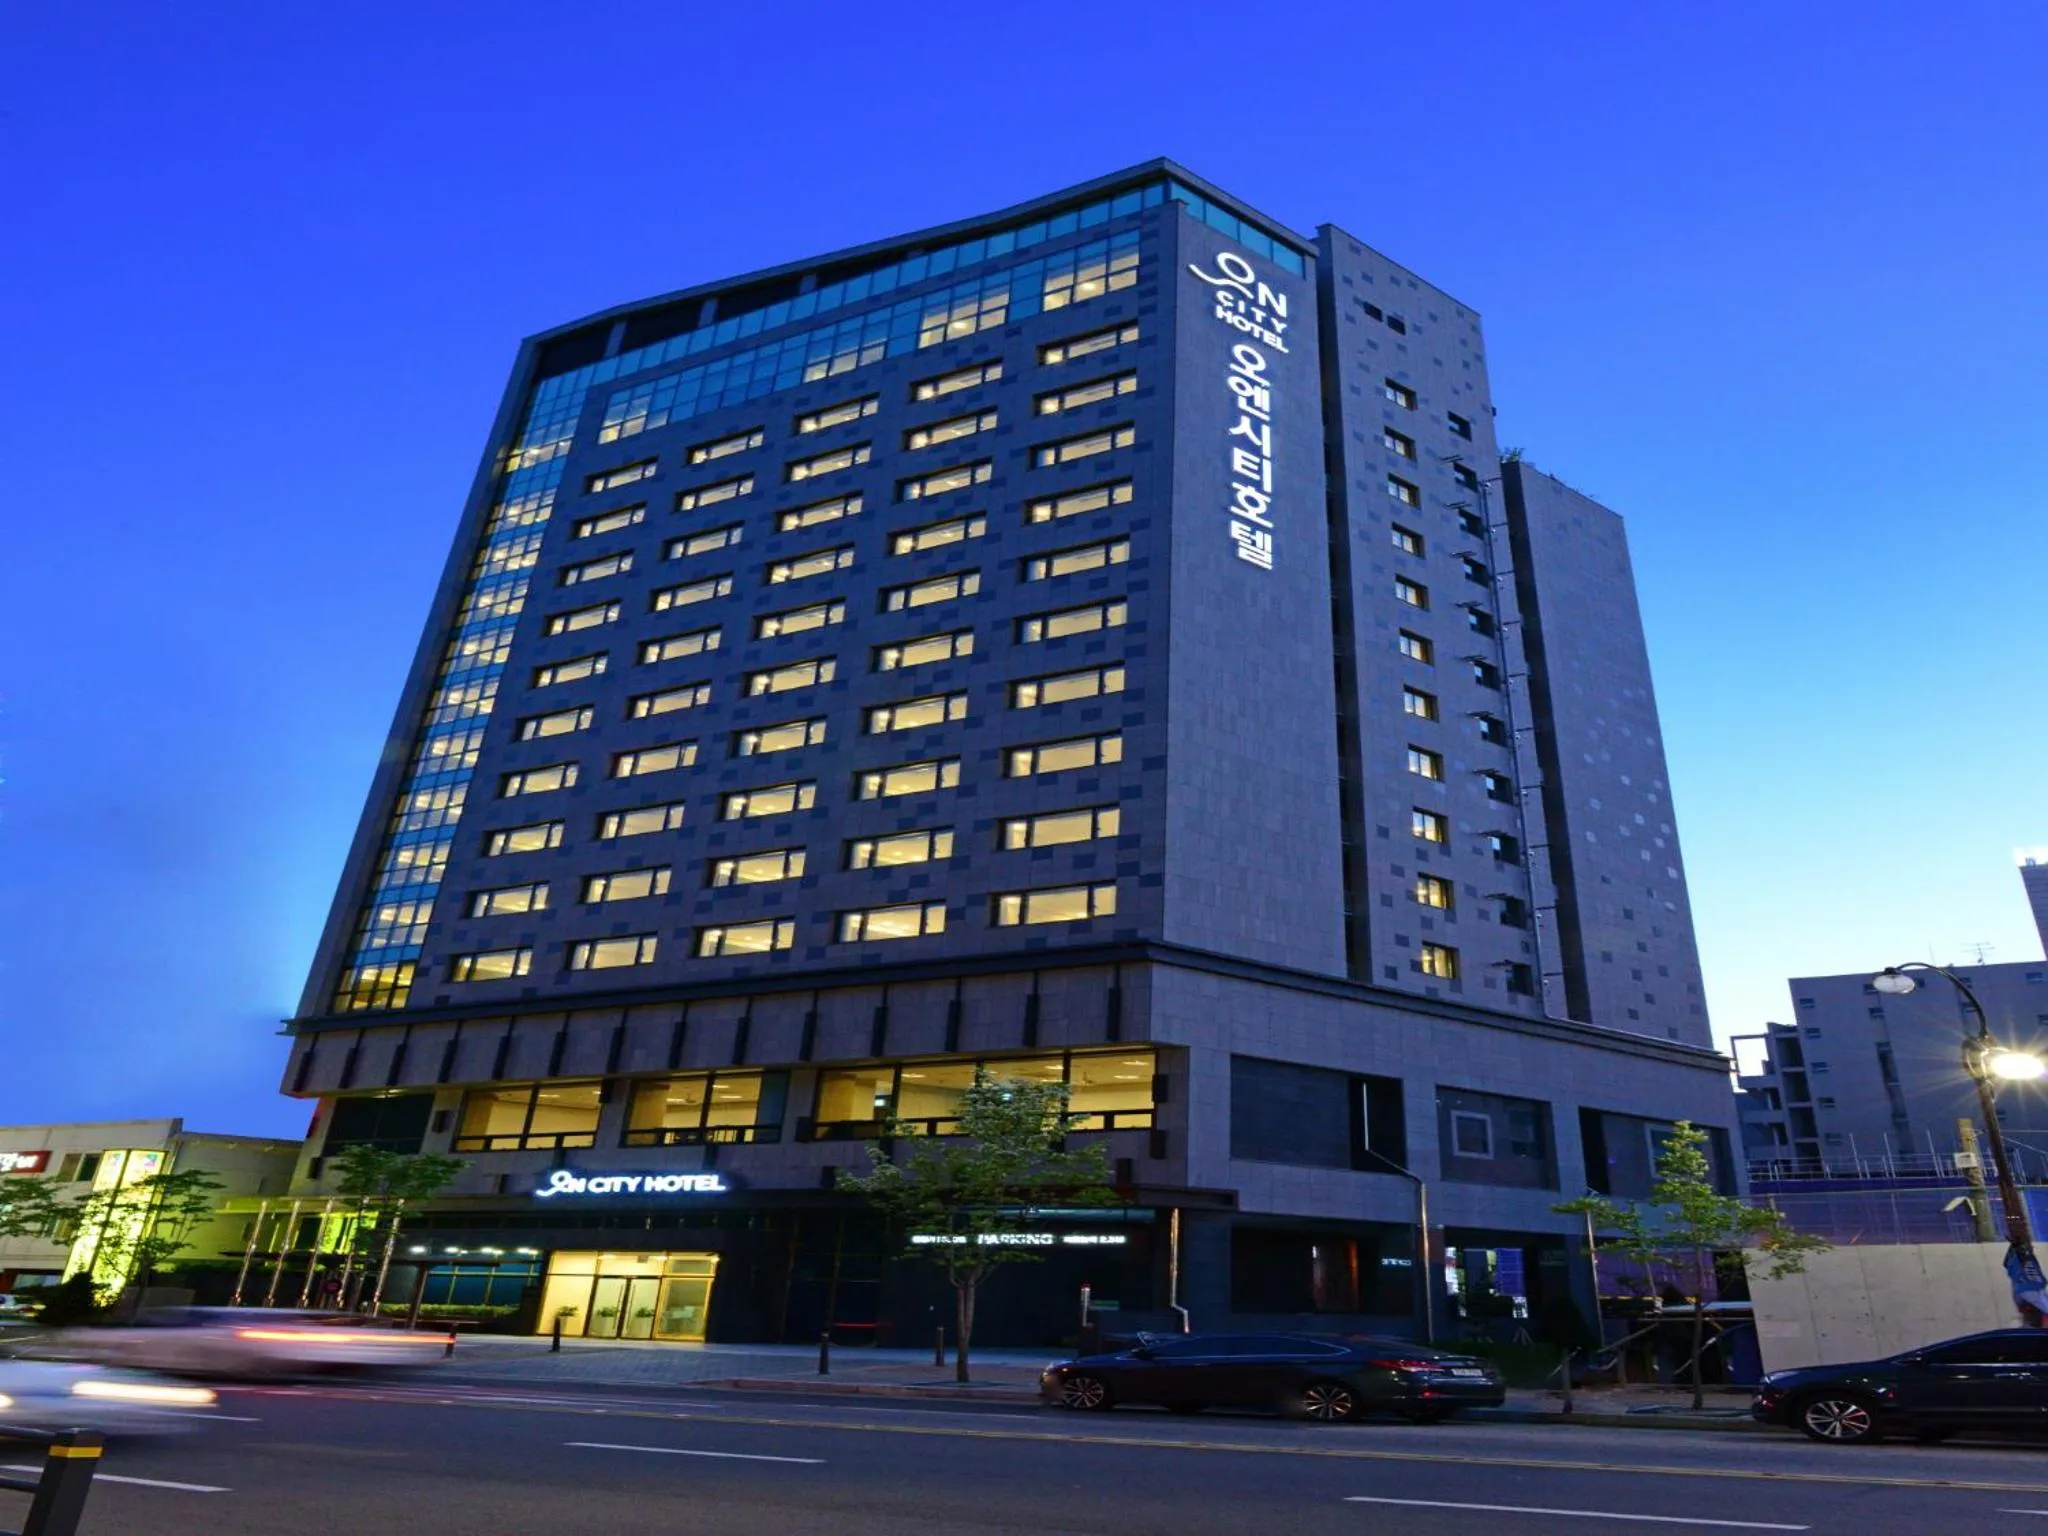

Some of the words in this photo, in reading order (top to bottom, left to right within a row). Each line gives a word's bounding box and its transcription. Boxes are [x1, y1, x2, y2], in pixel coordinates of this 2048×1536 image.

[1188, 251, 1288, 318] ON
[1215, 305, 1289, 353] HOTEL
[1216, 289, 1289, 334] CITY
[535, 1170, 586, 1197] ON
[587, 1176, 642, 1193] CITY
[644, 1175, 726, 1193] HOTEL
[977, 1233, 1054, 1245] PARKING
